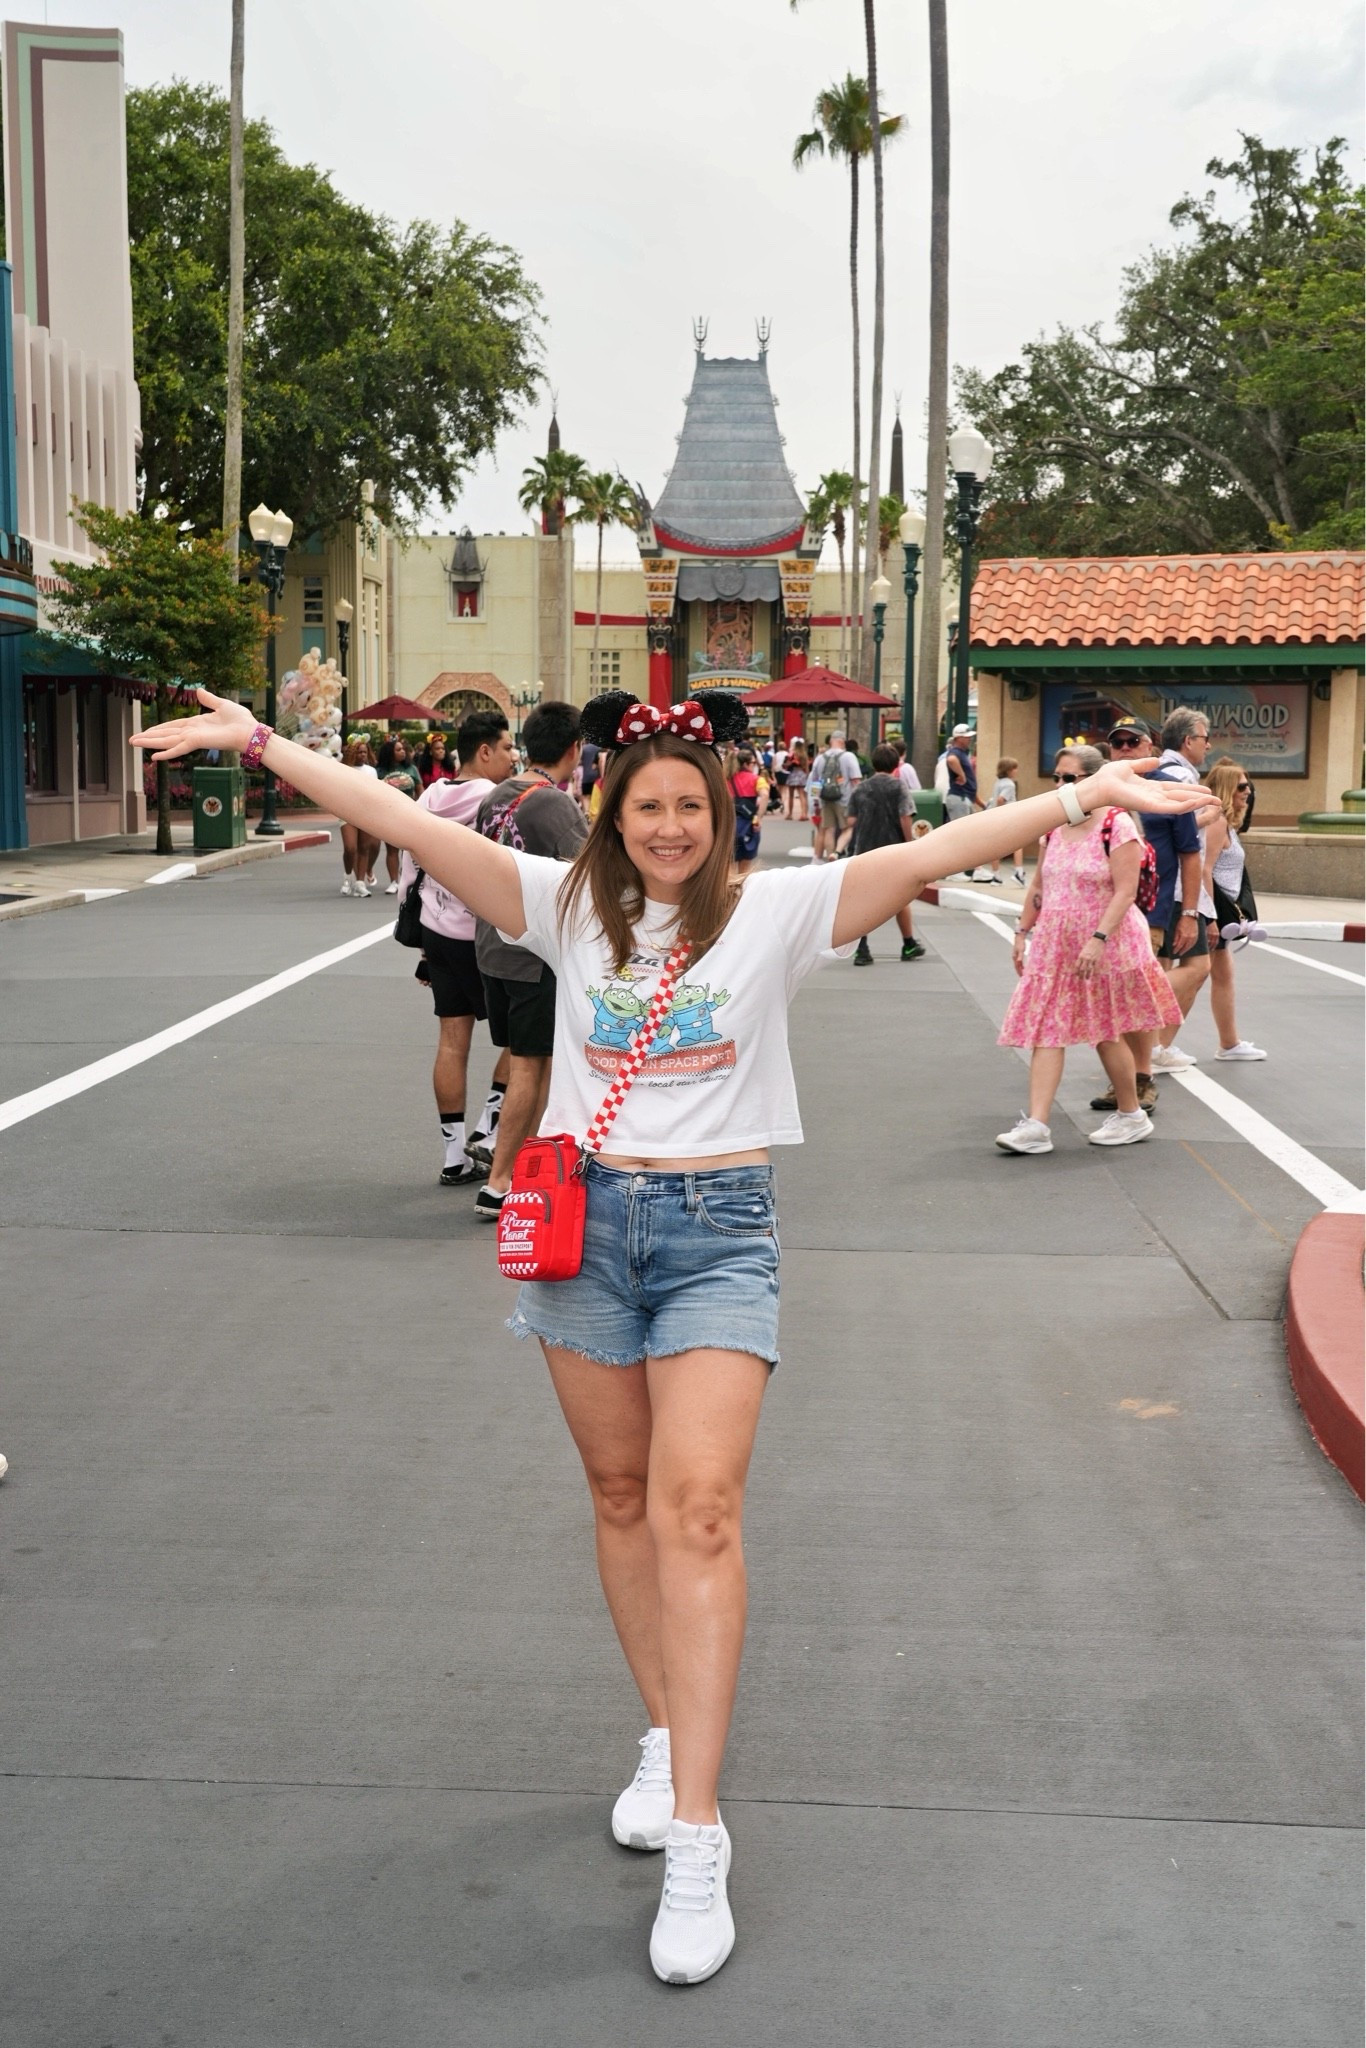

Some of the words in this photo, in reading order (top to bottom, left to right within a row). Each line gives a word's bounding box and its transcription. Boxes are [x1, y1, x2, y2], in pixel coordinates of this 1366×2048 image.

[1160, 699, 1289, 729] HYWOOD
[588, 1053, 618, 1068] FOOD
[640, 1060, 657, 1069] UN
[660, 1056, 699, 1069] SPACE
[702, 1050, 732, 1065] PORT
[648, 1080, 675, 1088] local
[508, 1210, 537, 1228] Pizza
[500, 1224, 535, 1242] Planet
